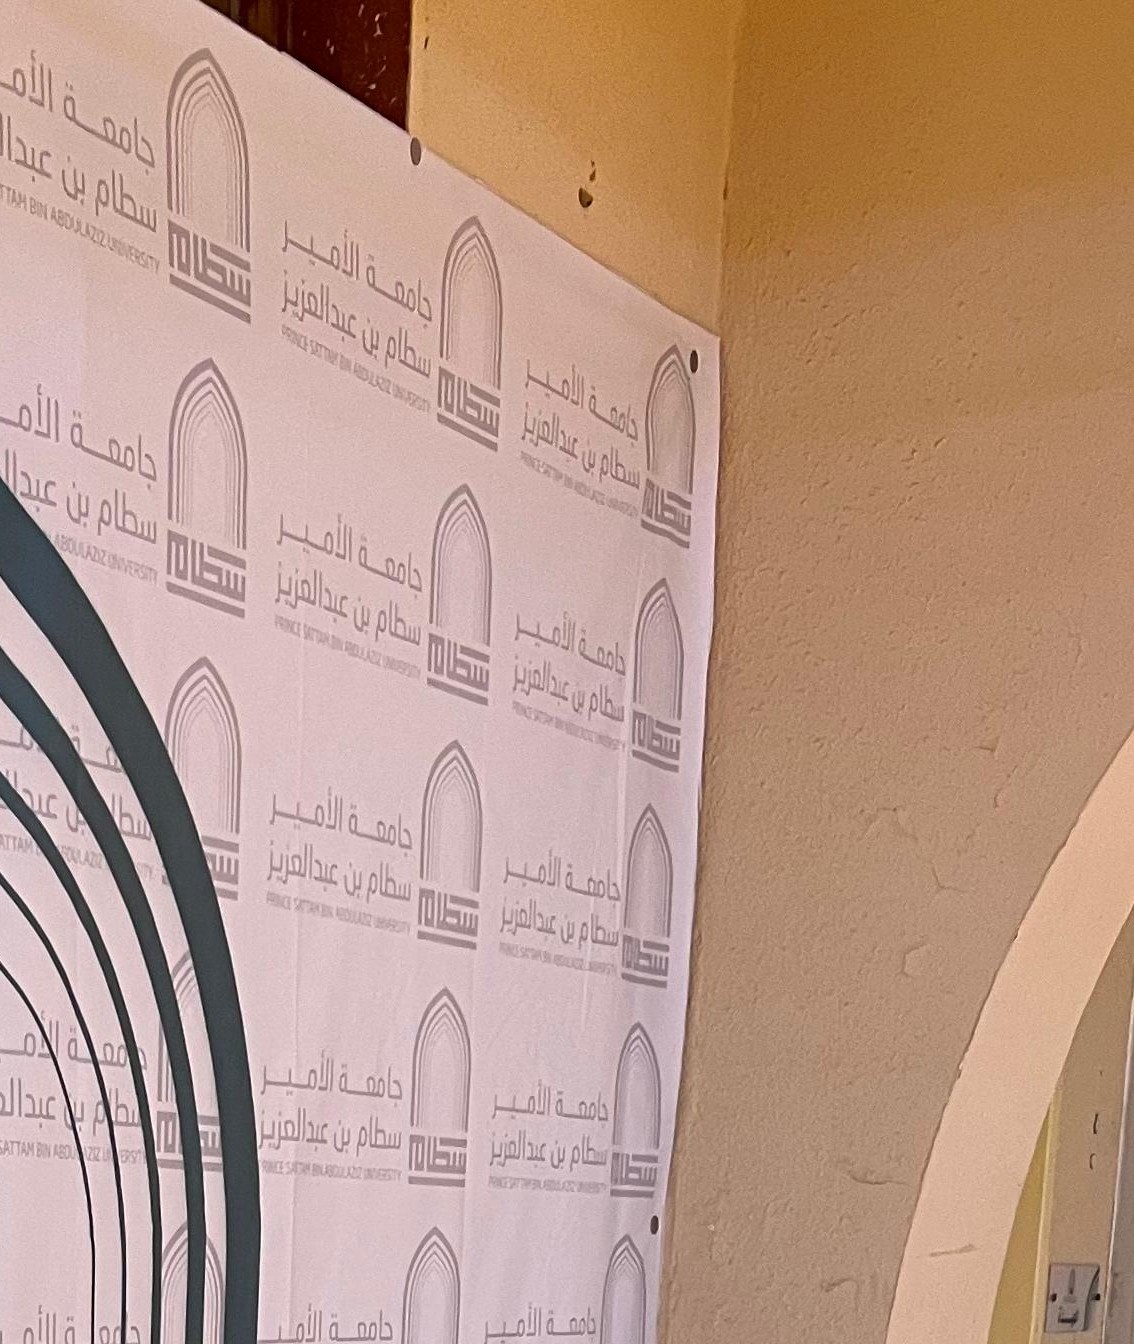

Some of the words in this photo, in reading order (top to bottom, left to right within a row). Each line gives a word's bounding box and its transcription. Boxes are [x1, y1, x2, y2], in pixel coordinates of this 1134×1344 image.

[62, 81, 155, 176] جامعة
[59, 155, 84, 207] بن
[93, 169, 157, 233] سطام
[280, 217, 359, 282] الأمير
[280, 267, 356, 343] عبدالعزيز
[365, 252, 432, 330] جامعة
[361, 316, 379, 360] بن
[384, 325, 431, 379] سطام
[523, 359, 584, 409] الأمير
[520, 401, 579, 463] عبدالعزيز
[587, 383, 638, 446] جامعة
[67, 408, 157, 491] جامعة
[581, 438, 597, 476] بن
[598, 444, 636, 489] سطام
[63, 481, 88, 530] بن
[96, 489, 157, 545] سطام
[260, 1049, 334, 1096] الأمير
[339, 1062, 402, 1108] جامعة
[489, 1077, 551, 1120] الأمير
[554, 1089, 607, 1129] جامعة
[257, 1106, 330, 1152] عبدالعزيز
[334, 1118, 352, 1154] بن
[355, 1114, 401, 1158] سطام
[487, 1128, 547, 1169] عبدالعزيز
[550, 1138, 565, 1170] بن
[568, 1134, 606, 1173] سطام
